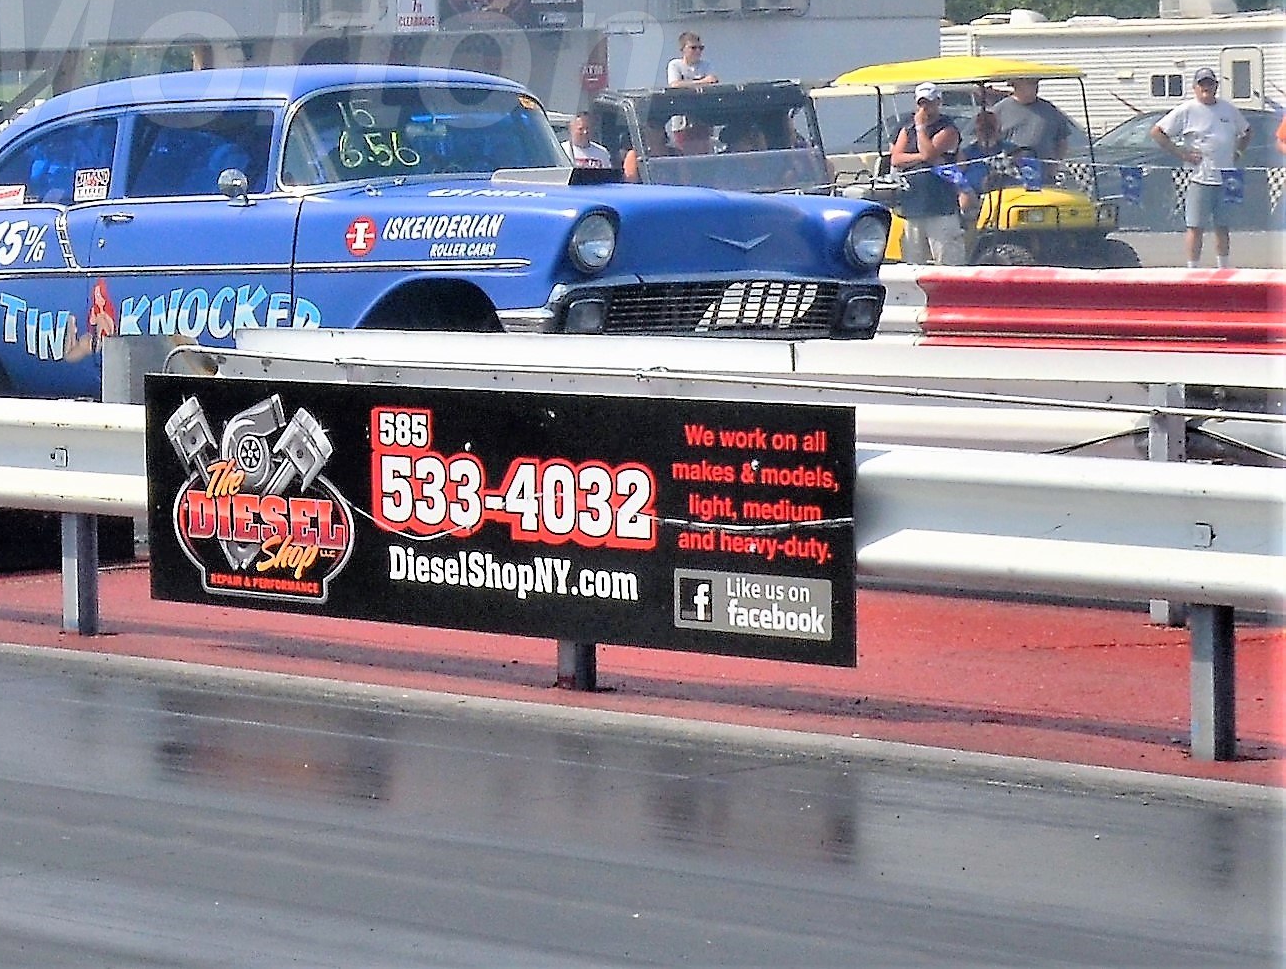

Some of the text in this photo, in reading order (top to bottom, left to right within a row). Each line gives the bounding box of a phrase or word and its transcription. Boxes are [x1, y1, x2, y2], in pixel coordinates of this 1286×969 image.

[337, 98, 377, 129] 15
[381, 213, 506, 241] ISKENDERIAN
[429, 243, 497, 258] ROLLER CAMS
[378, 411, 429, 448] 585
[684, 423, 828, 453] We work on all
[205, 457, 249, 499] The
[672, 459, 841, 493] makes & models,
[380, 454, 653, 541] 533-4032
[688, 493, 823, 522] light, medium
[186, 489, 346, 550] DIESEL
[256, 535, 320, 580] Shop
[677, 531, 834, 566] and heavy-duty.
[210, 573, 242, 587] REPAIR
[252, 577, 321, 595] PERFORMANCE
[388, 543, 640, 602] DieselShopNY.com
[725, 576, 812, 603] Like us on
[727, 599, 826, 635] facebook
